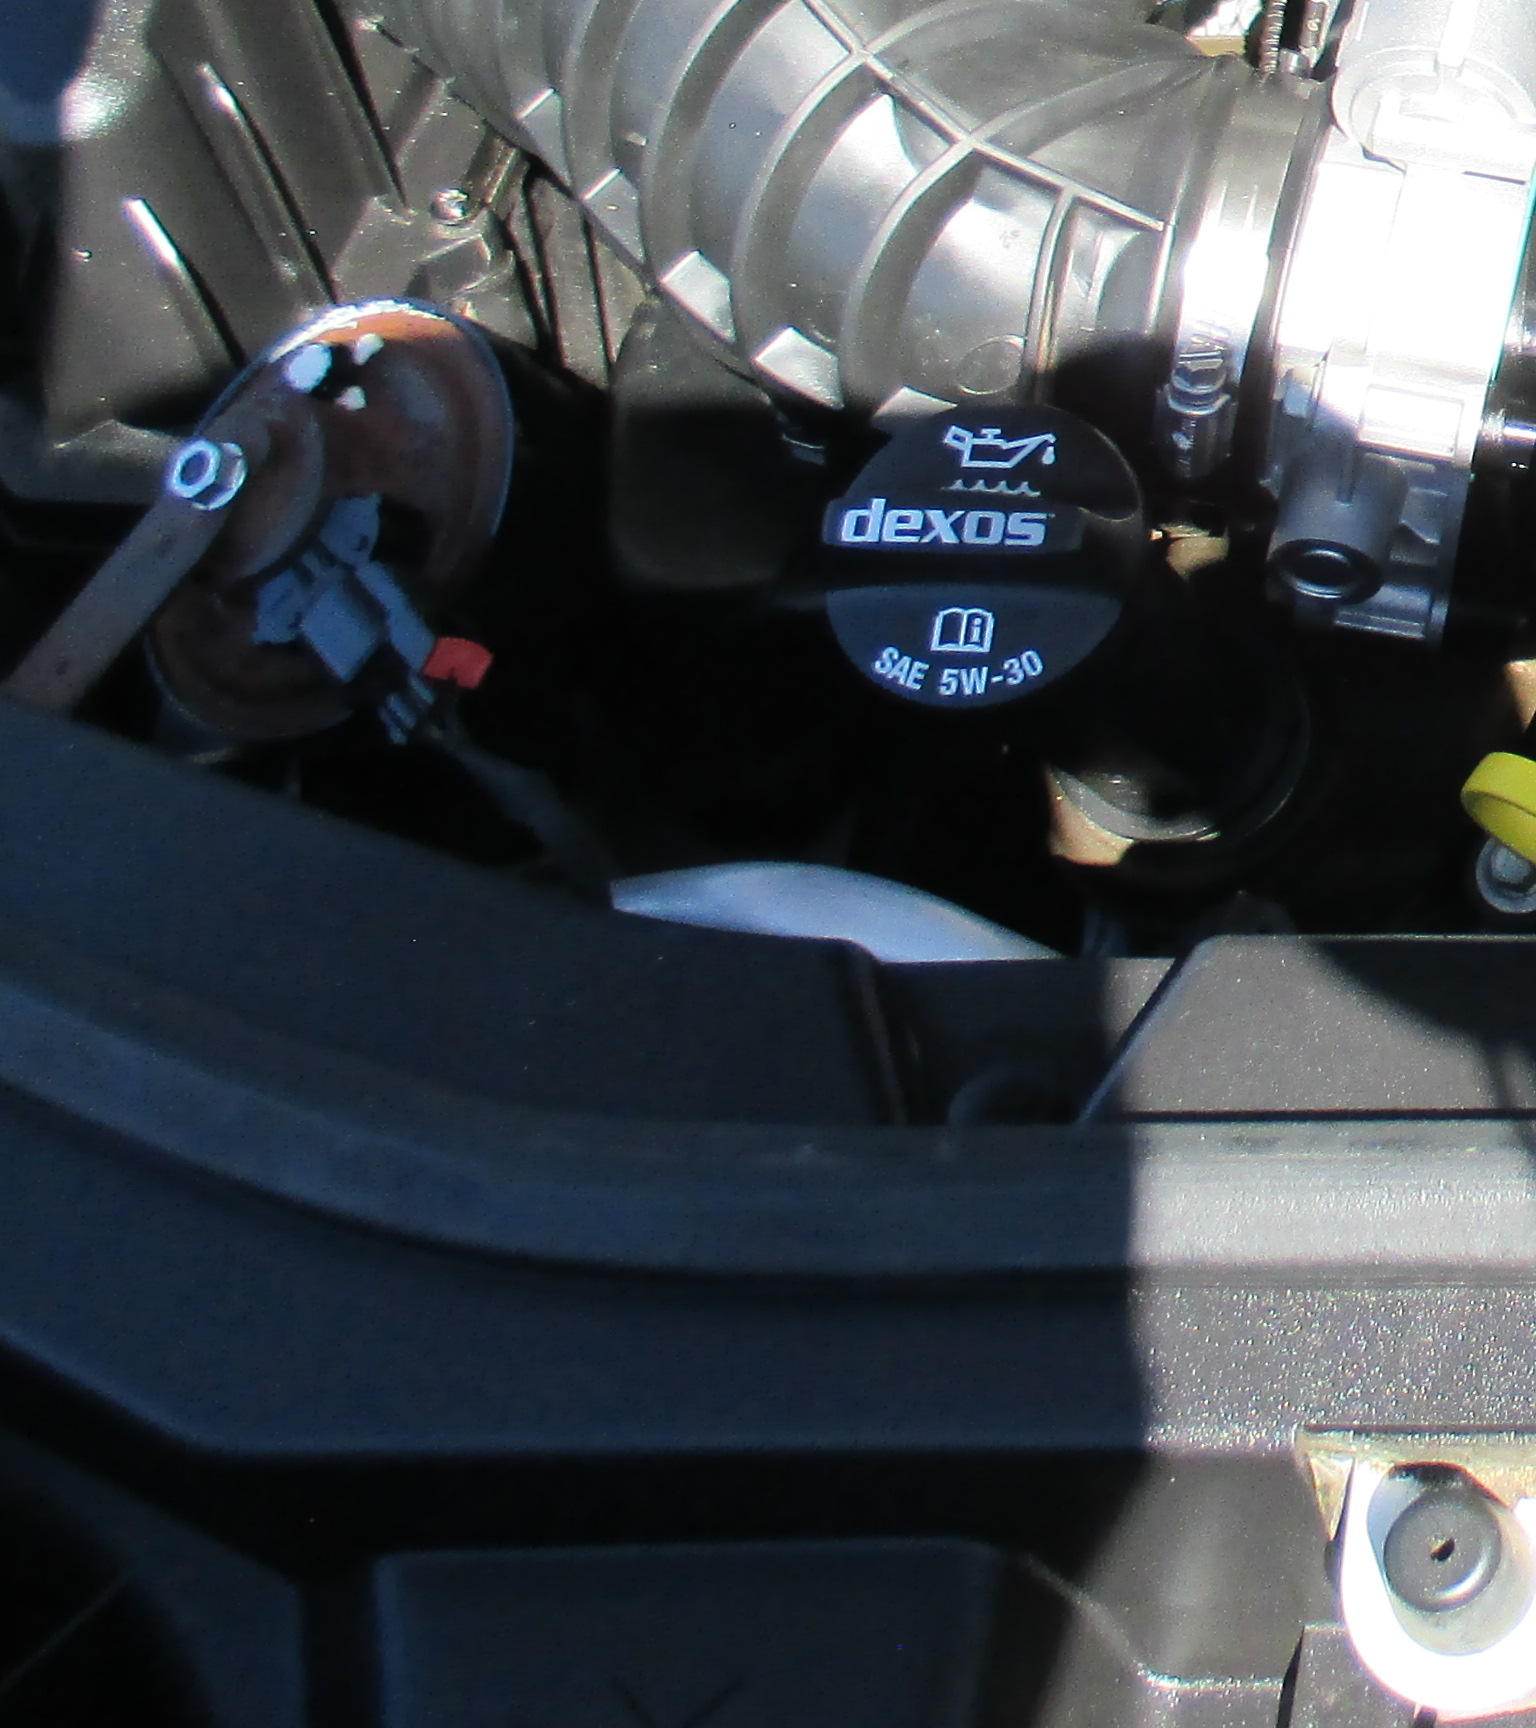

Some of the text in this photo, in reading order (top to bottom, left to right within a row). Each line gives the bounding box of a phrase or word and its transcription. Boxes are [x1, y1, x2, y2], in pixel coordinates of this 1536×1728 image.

[840, 498, 1048, 547] dexos
[874, 646, 1044, 696] SAE 5W-30
